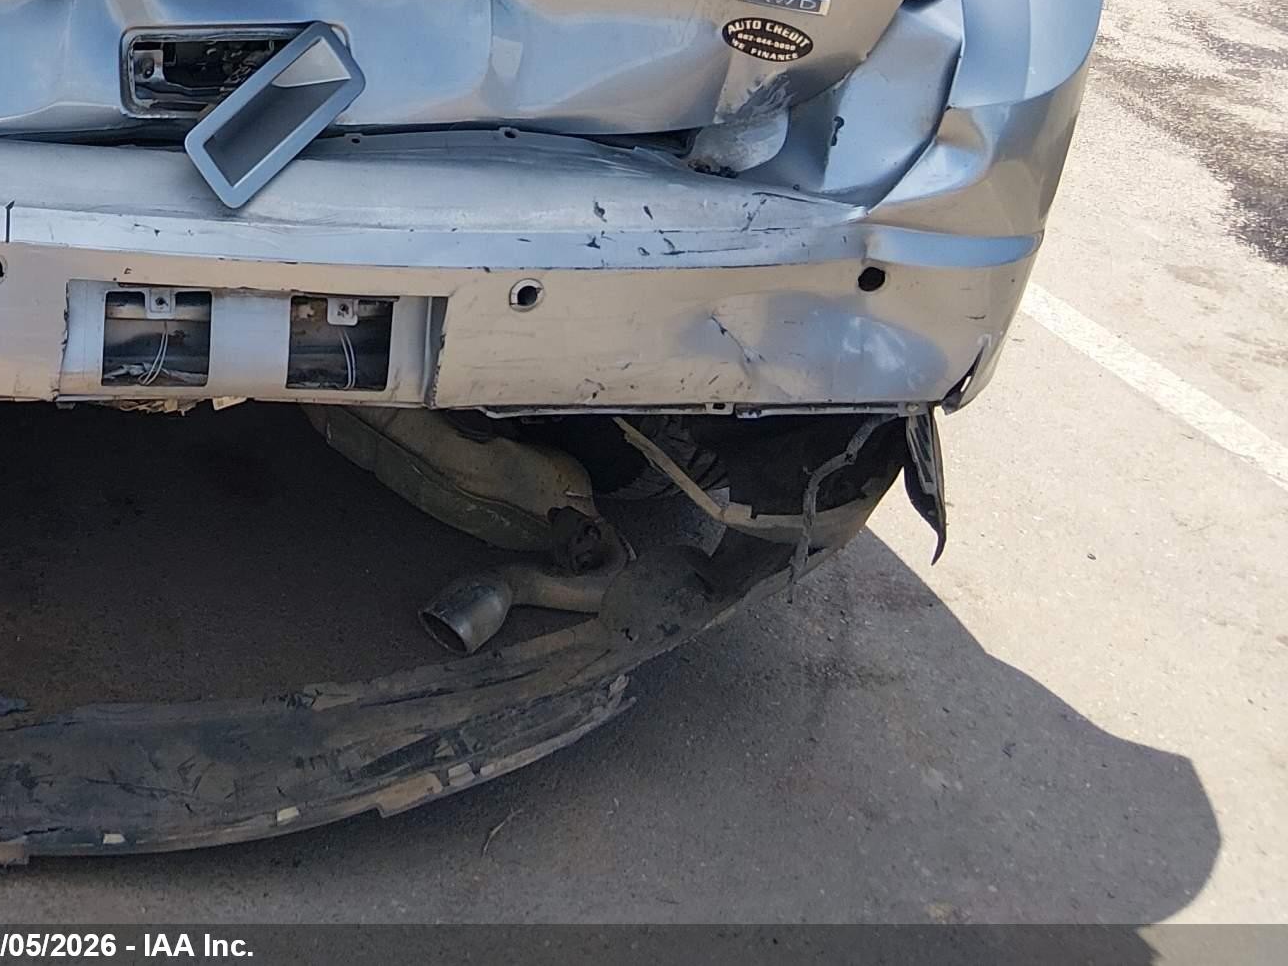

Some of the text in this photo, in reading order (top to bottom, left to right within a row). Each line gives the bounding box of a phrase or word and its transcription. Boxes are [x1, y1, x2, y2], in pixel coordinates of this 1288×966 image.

[728, 20, 810, 47] AUTO CREDIT
[732, 38, 799, 61] WE FINANCE
